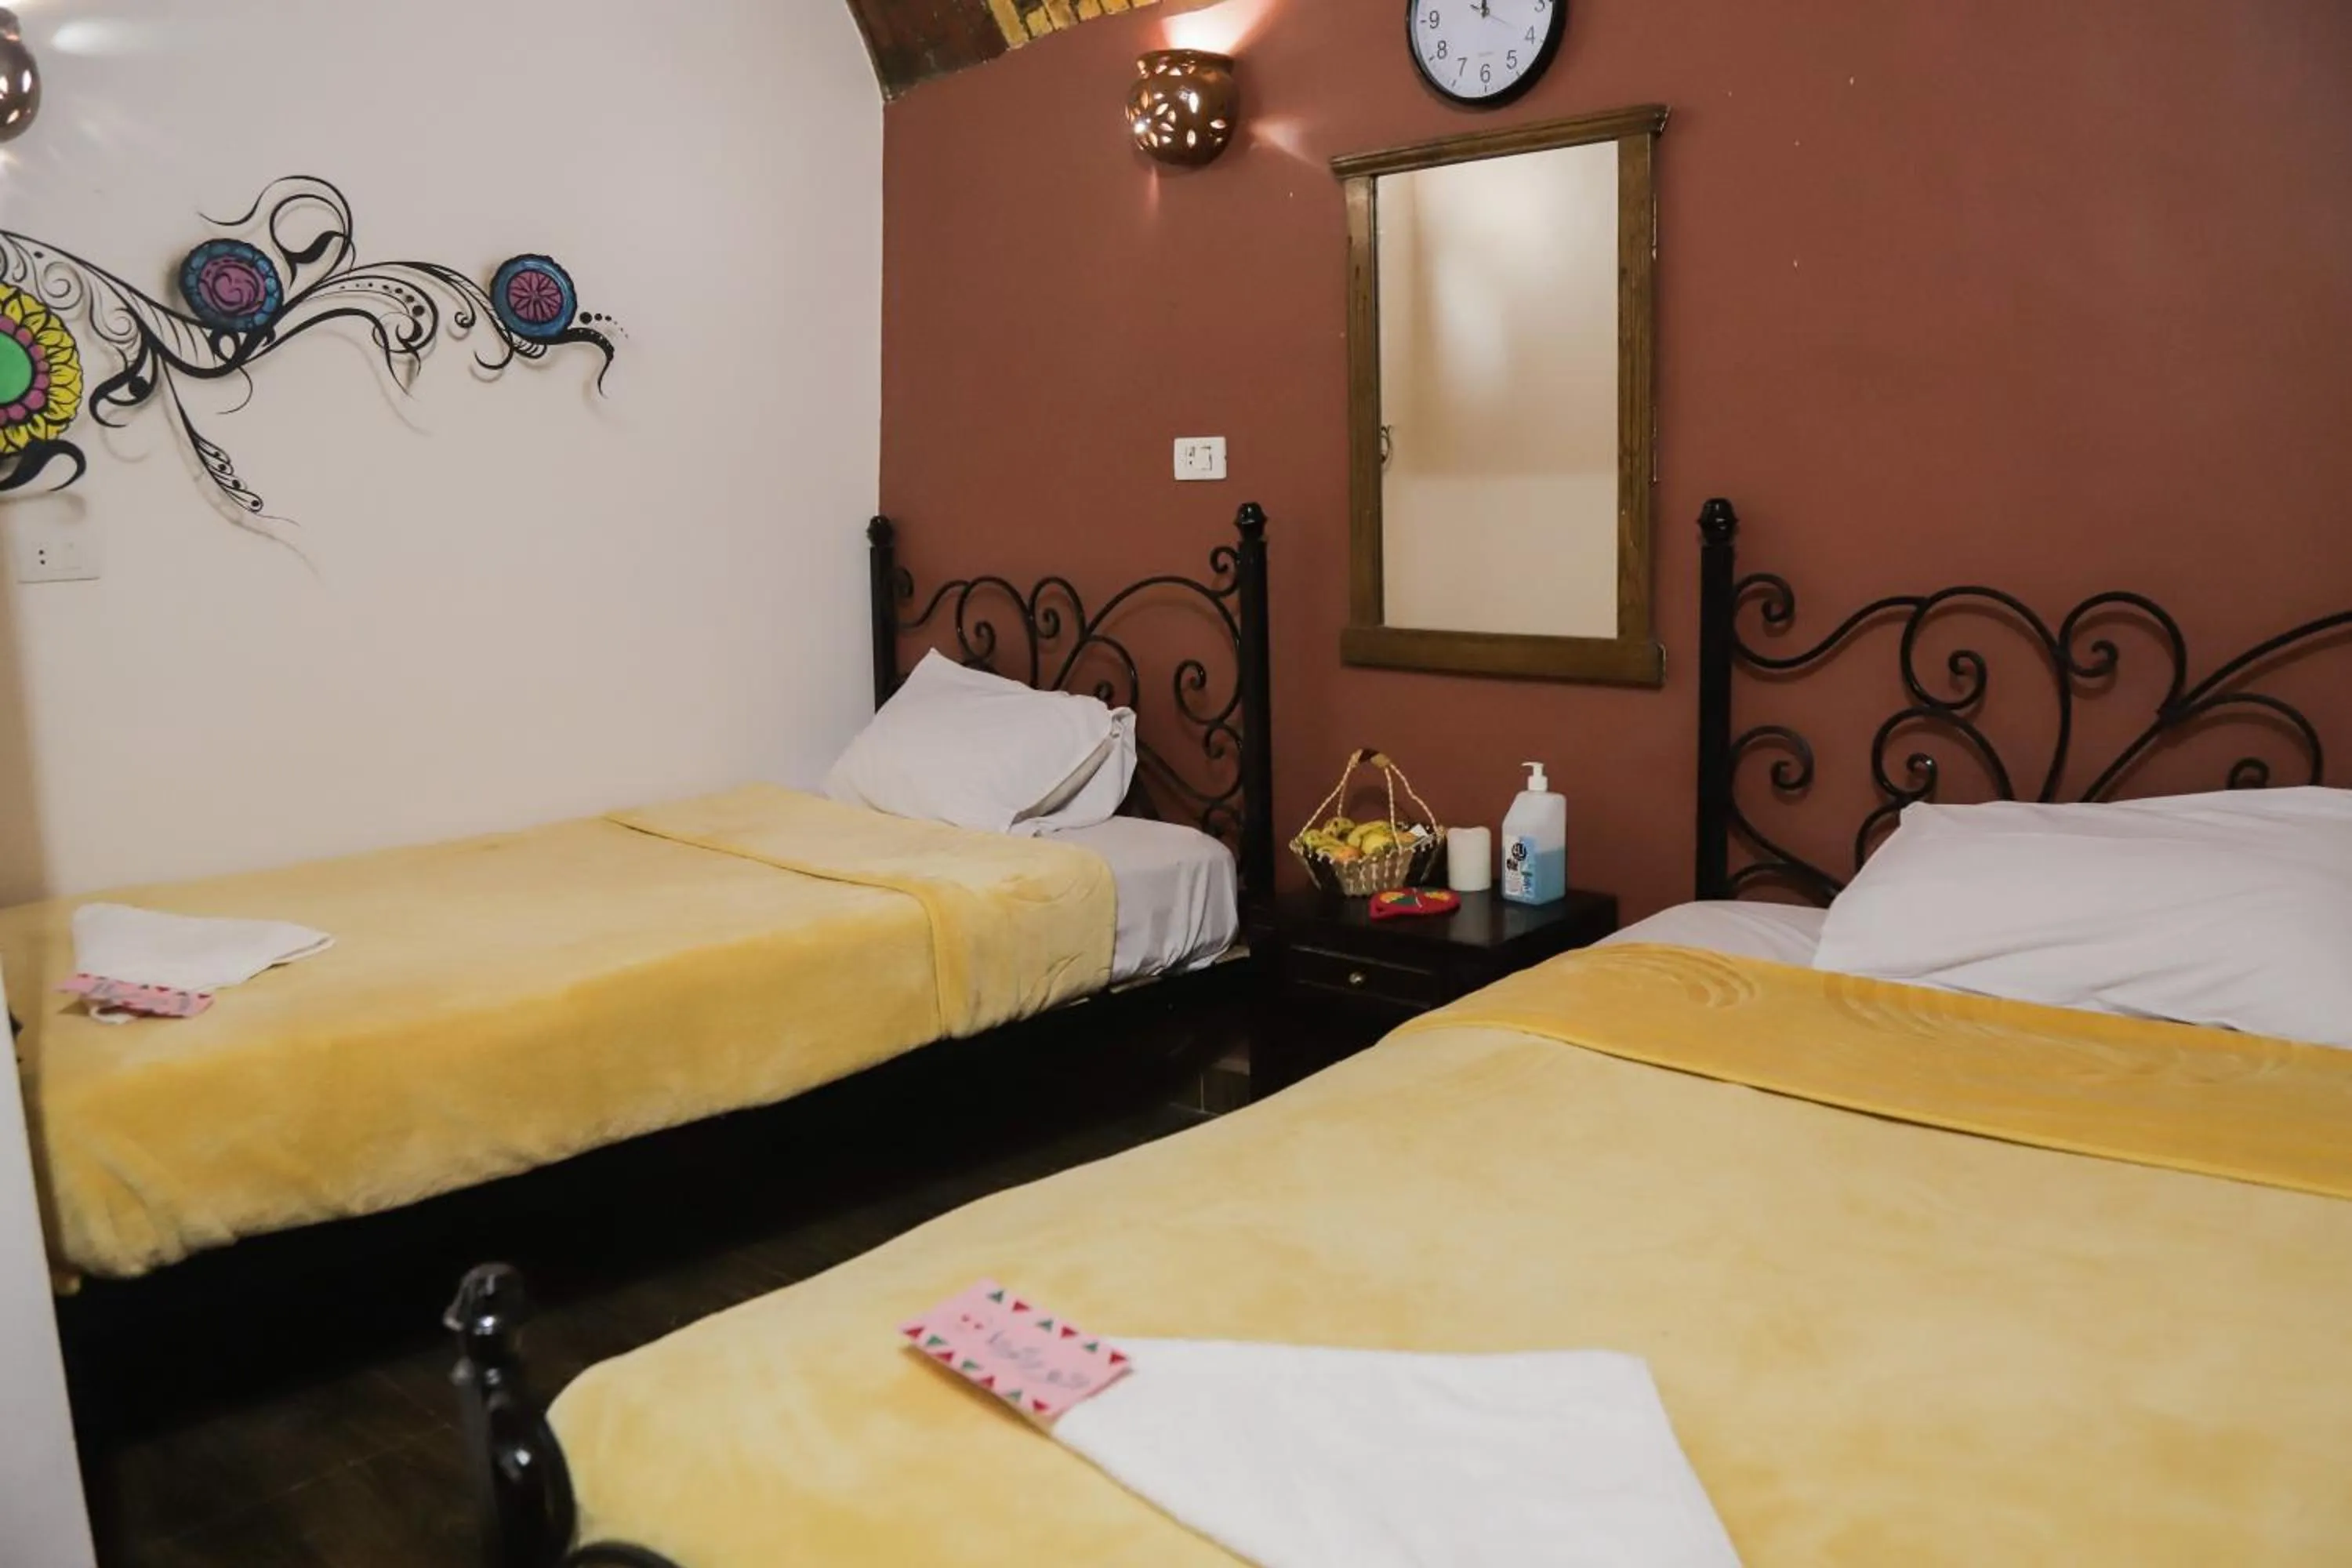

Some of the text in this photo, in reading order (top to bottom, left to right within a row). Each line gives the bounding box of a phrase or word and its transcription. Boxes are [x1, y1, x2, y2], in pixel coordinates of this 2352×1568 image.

[1429, 10, 1439, 29] 9
[1525, 25, 1535, 45] 4
[1437, 40, 1447, 60] 8
[1506, 49, 1517, 70] 5
[1457, 57, 1468, 77] 7
[1479, 64, 1490, 83] 6
